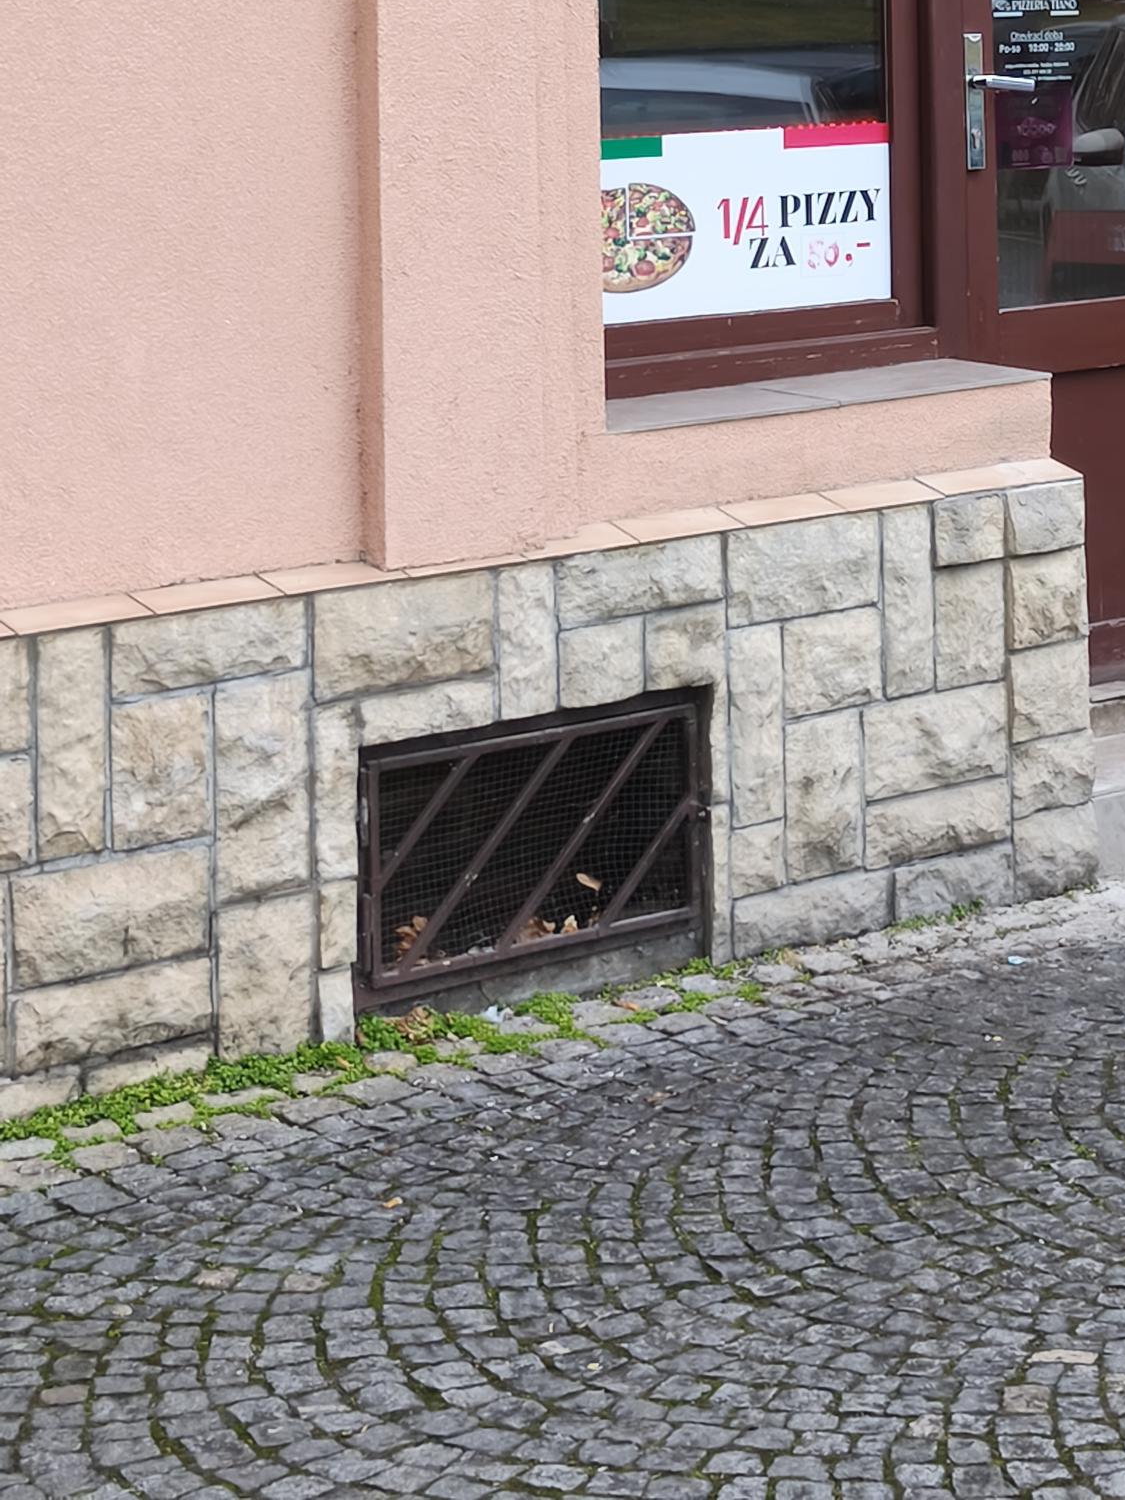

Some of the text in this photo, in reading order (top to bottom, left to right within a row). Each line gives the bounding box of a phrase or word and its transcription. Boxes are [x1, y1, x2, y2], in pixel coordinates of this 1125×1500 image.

[1011, 0, 1050, 11] PIZZERIA
[717, 188, 881, 246] 1/4 PIZZY
[749, 236, 797, 269] ZA
